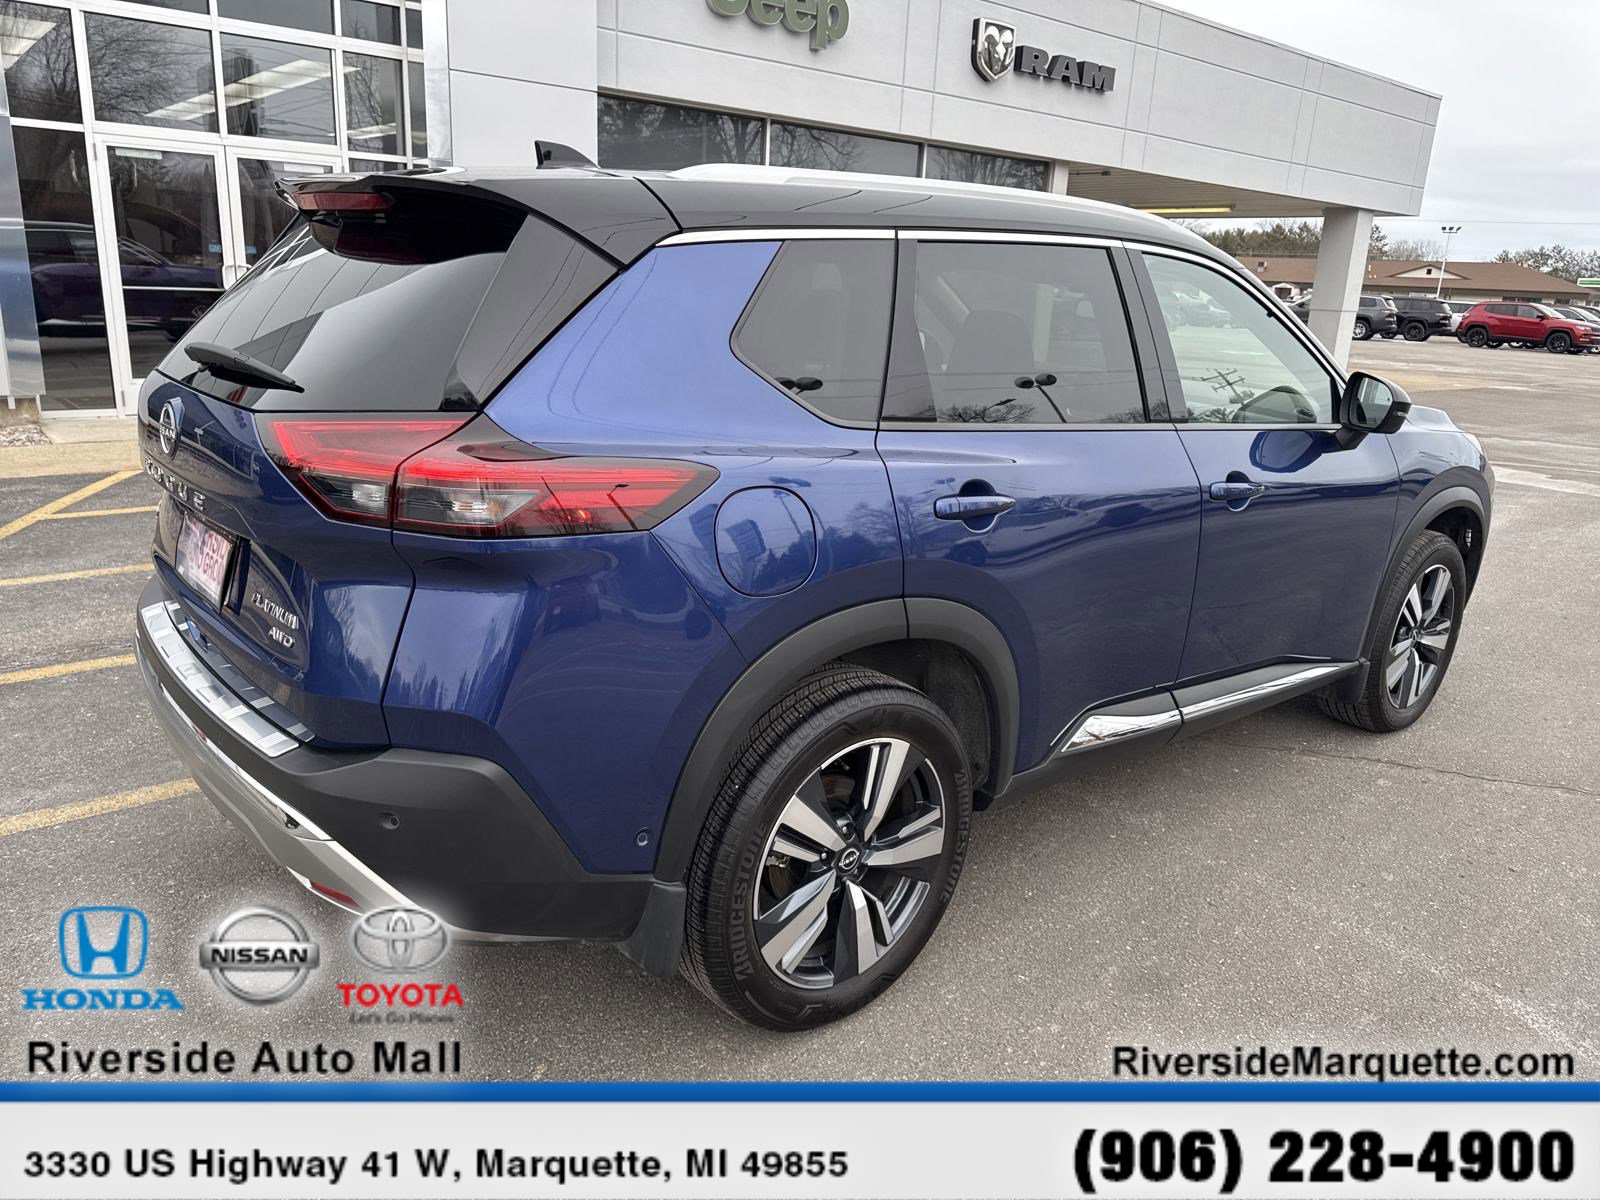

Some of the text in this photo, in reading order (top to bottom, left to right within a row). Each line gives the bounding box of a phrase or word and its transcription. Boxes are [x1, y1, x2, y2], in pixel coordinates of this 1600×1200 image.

[1015, 45, 1117, 92] RAM
[145, 456, 206, 511] ROGUE
[251, 592, 299, 630] PLATINUM
[268, 626, 295, 648] AWD
[730, 821, 768, 982] BRIDGESTONE
